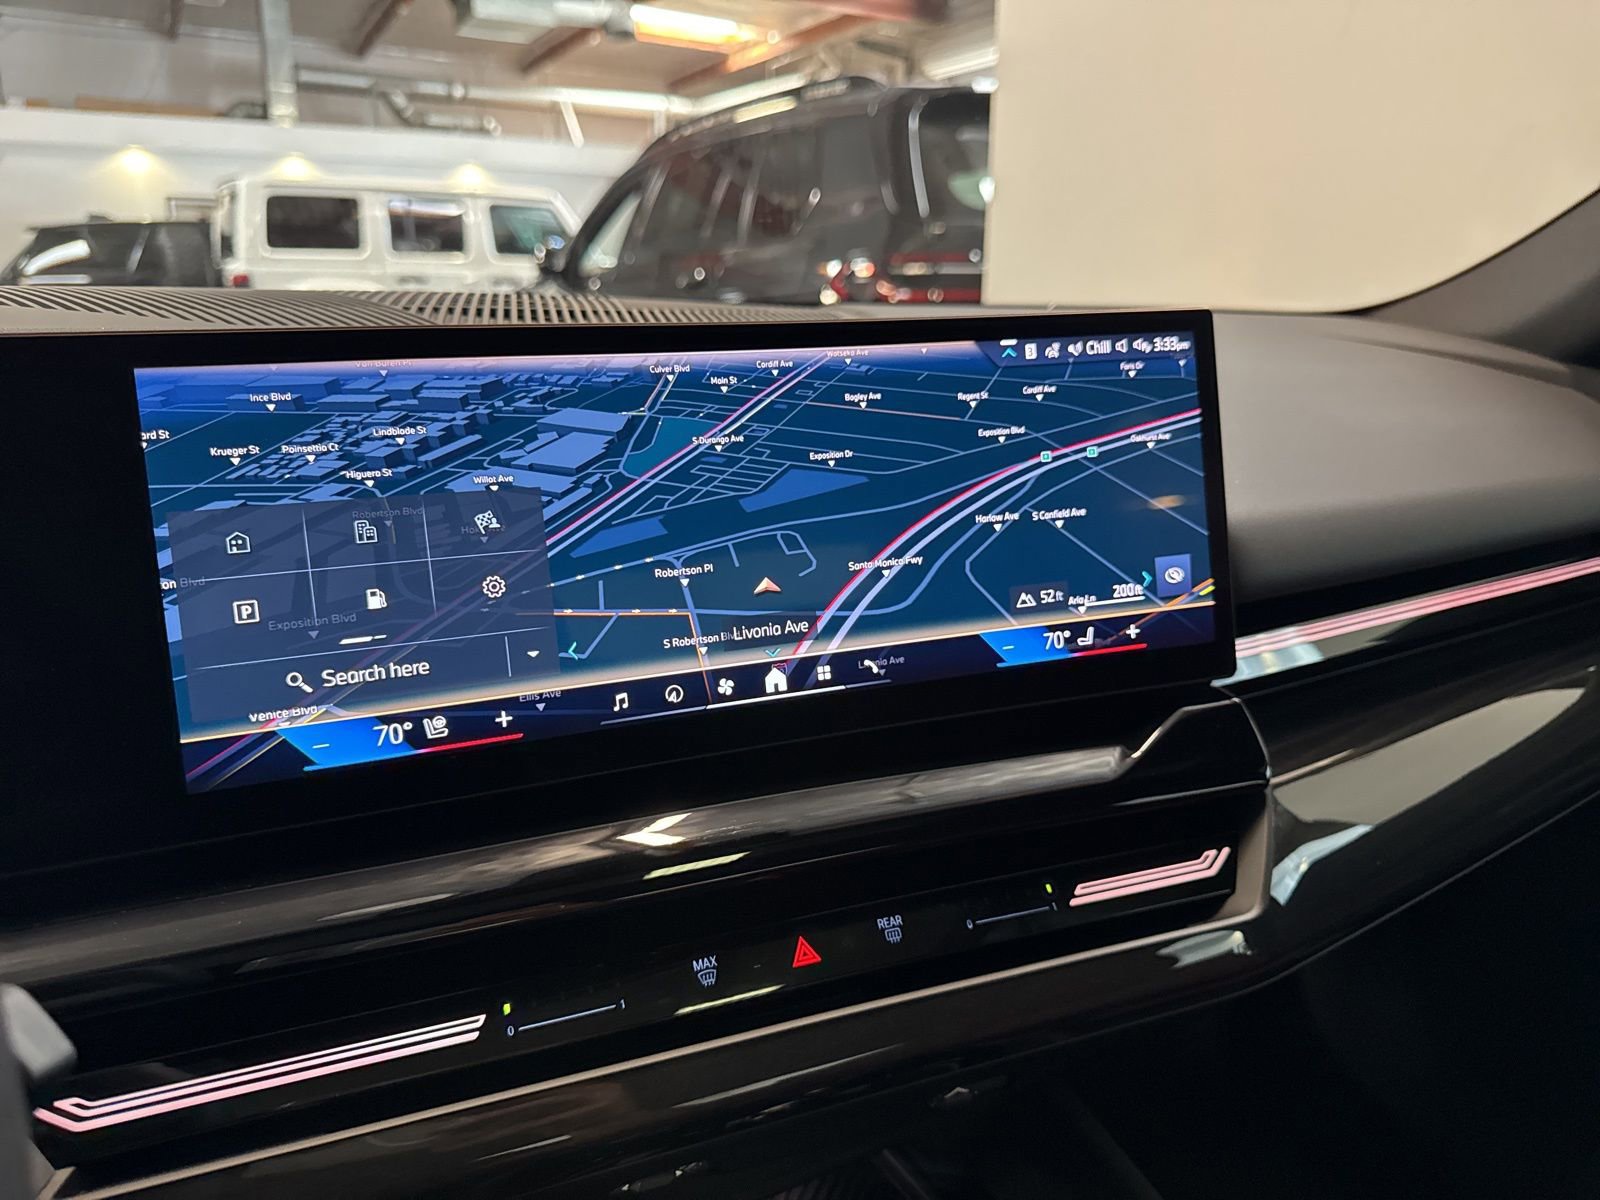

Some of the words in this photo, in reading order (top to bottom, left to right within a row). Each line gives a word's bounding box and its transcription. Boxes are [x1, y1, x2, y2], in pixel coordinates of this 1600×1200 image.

[1086, 339, 1112, 355] Chill
[650, 365, 671, 374] Culver
[673, 364, 690, 372] Blvd
[756, 360, 778, 368] Cardiff
[779, 360, 794, 368] Ave
[711, 376, 727, 384] Main
[728, 376, 738, 384] St
[1022, 386, 1043, 394] Cardiff
[1044, 384, 1056, 392] Ave
[250, 394, 268, 402] Ince
[271, 392, 292, 401] Blvd
[844, 393, 867, 402] Bagley
[868, 392, 882, 400] Ave
[958, 392, 980, 402] Regent
[158, 430, 170, 440] St
[373, 426, 416, 436] Lindblade
[417, 426, 427, 435] St
[978, 428, 1010, 438] Exposition
[1010, 426, 1026, 434] Blvd
[692, 436, 698, 444] S
[700, 436, 729, 446] Durango
[730, 434, 744, 442] Ave
[210, 446, 246, 457] Krueger
[246, 445, 260, 454] St
[282, 444, 328, 454] Poinsettia
[330, 442, 340, 452] Ct
[810, 452, 840, 462] Exposition
[840, 450, 853, 458] Dr
[346, 469, 382, 480] Higuera
[382, 468, 392, 478] St
[498, 474, 514, 482] Ave
[352, 509, 400, 520] Robertson
[976, 514, 1003, 524] Harlow
[1004, 512, 1020, 520] Ave
[1032, 512, 1038, 521] S
[1039, 508, 1070, 520] Canfield
[1071, 508, 1087, 516] Ave
[848, 561, 874, 571] Santa
[874, 558, 904, 568] Monica
[906, 556, 924, 566] Fwy
[654, 566, 702, 578] Robertson
[704, 564, 714, 574] Pl
[268, 617, 329, 632] Exposition
[332, 613, 356, 624] Blvd
[733, 622, 782, 641] Livonia
[785, 619, 809, 634] Ave
[663, 638, 671, 648] S
[672, 632, 720, 648] Robertson
[1043, 630, 1071, 650] 70°
[889, 656, 905, 664] Ave
[322, 664, 386, 688] Search
[390, 660, 430, 678] here
[542, 690, 562, 699] Ave
[248, 709, 289, 722] Venice
[372, 721, 413, 747] 70°
[877, 914, 904, 930] REAR
[966, 919, 974, 930] 0
[692, 954, 718, 972] MAX
[620, 998, 626, 1010] 1
[507, 1025, 515, 1037] 0
